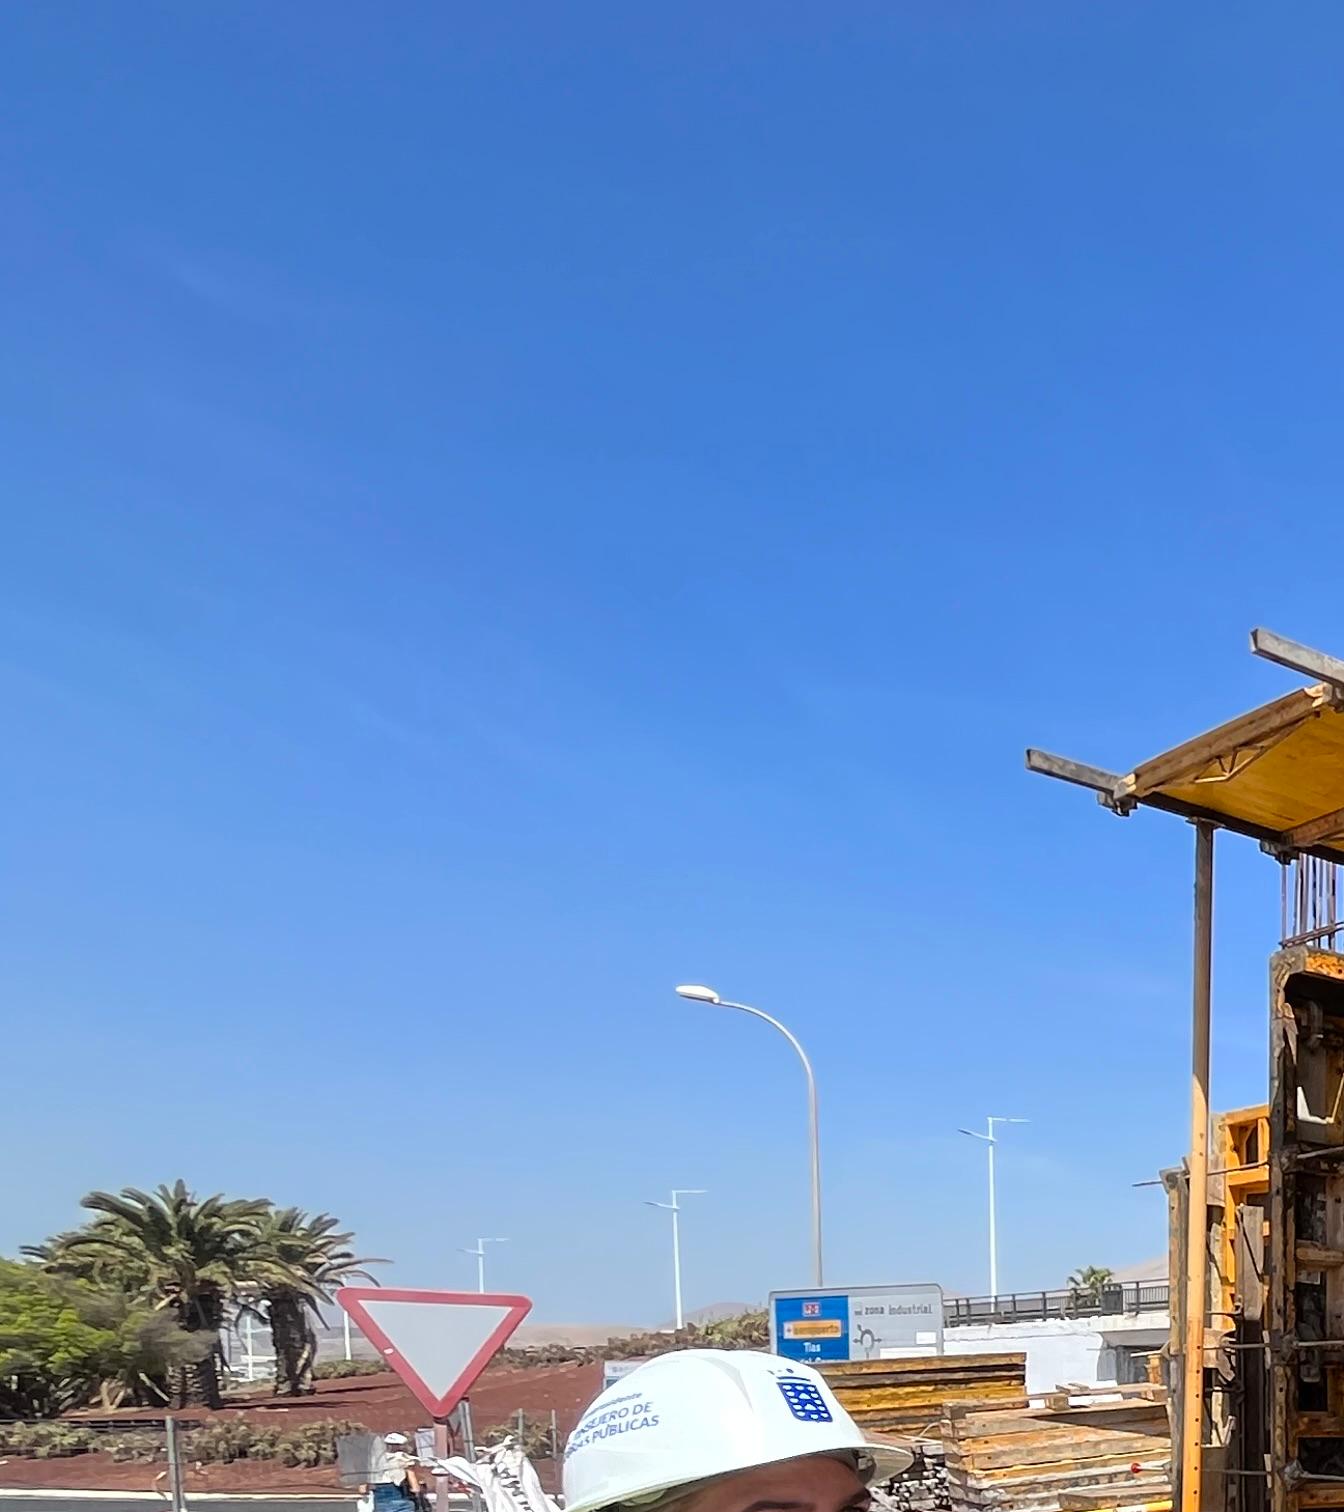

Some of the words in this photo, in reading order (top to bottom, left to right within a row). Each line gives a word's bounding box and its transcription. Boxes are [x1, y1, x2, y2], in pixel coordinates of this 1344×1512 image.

[865, 1306, 884, 1315] zona
[888, 1304, 932, 1315] industrial
[573, 1406, 630, 1441] ONSEJERO
[632, 1401, 654, 1416] DE
